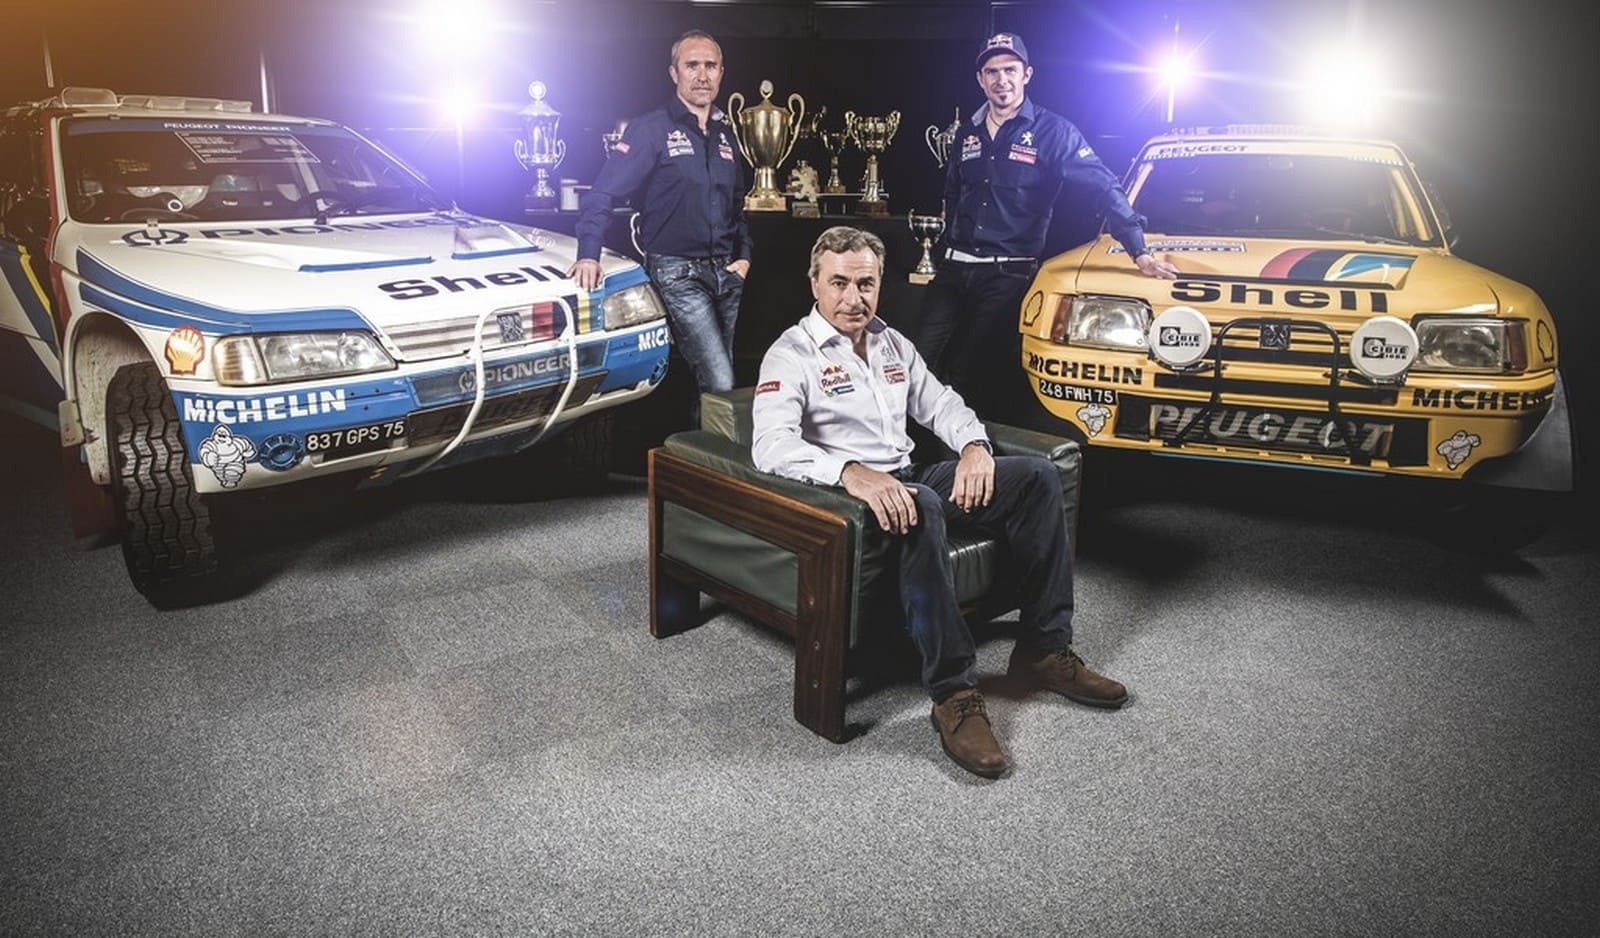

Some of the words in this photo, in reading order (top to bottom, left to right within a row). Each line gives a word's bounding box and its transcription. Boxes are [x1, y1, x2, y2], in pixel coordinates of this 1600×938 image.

[163, 122, 220, 130] PEUGEOT
[1160, 144, 1248, 154] PEUGEOT
[377, 264, 572, 300] Shell
[1169, 280, 1389, 313] Shell
[484, 353, 572, 383] PIONEER
[1028, 352, 1143, 385] MICHELIN
[183, 388, 347, 424] MICHELIN
[1039, 379, 1063, 399] 248
[1064, 385, 1093, 401] FWH
[1096, 390, 1114, 404] 75
[306, 430, 343, 451] 837
[346, 425, 380, 446] GPS
[383, 420, 405, 438] 75
